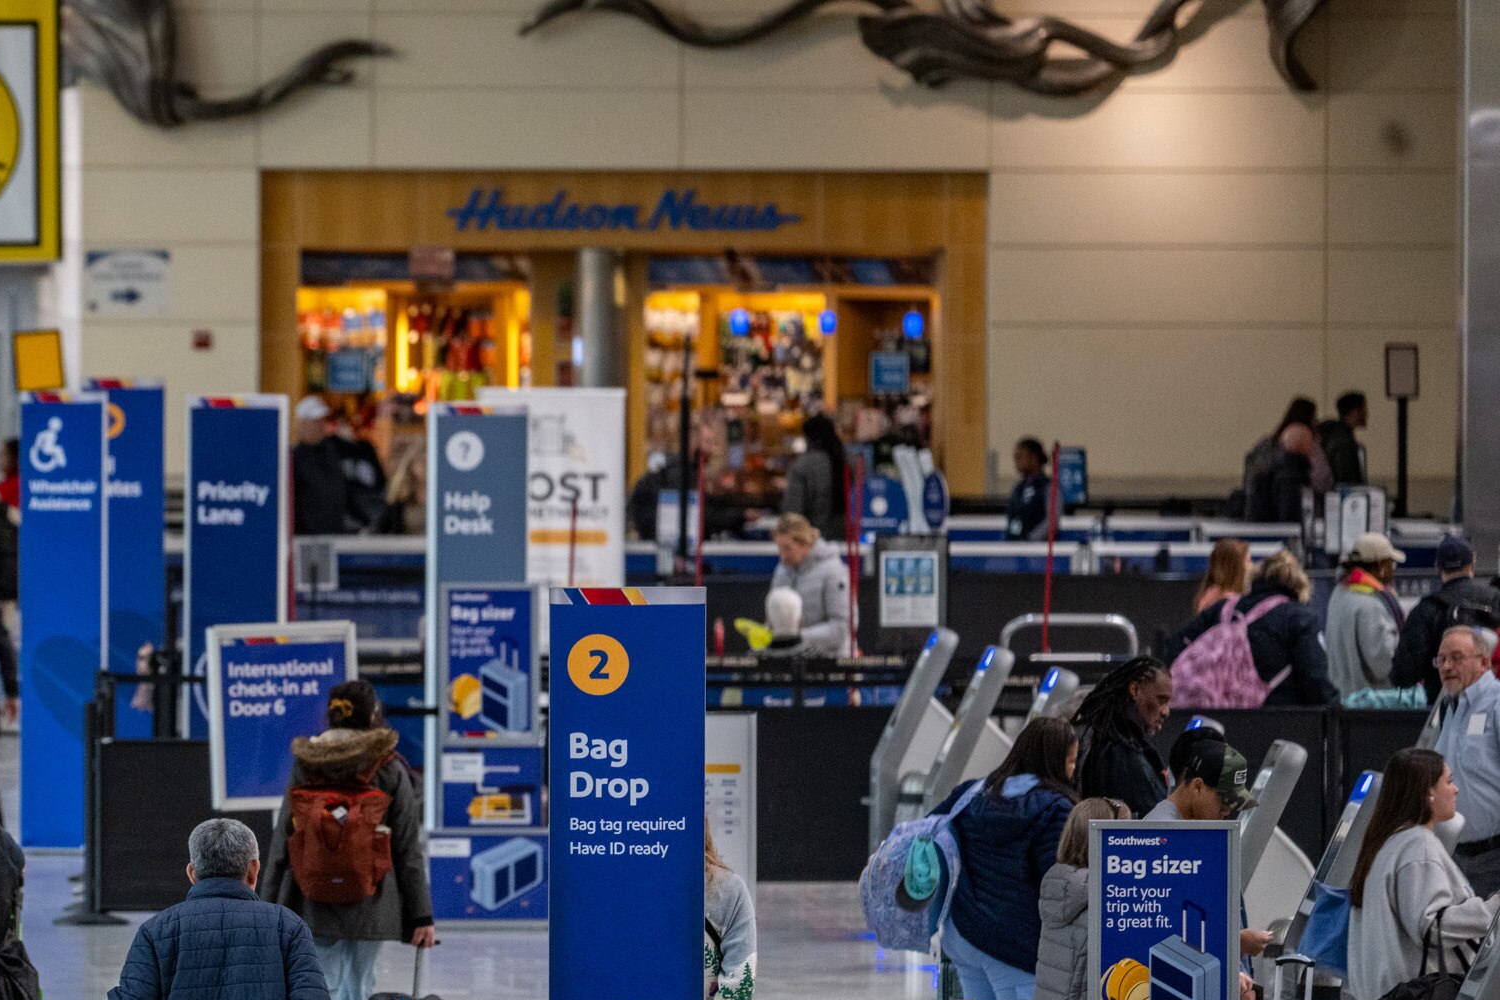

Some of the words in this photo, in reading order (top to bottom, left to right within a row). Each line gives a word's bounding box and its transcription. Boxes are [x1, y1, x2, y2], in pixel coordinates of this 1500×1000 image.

[446, 188, 641, 231] Hudson
[643, 188, 803, 231] News
[28, 479, 97, 495] Wheelchair
[197, 481, 270, 507] Priority
[528, 472, 607, 502] OST
[28, 497, 93, 511] Assistance
[444, 490, 492, 513] Help
[197, 505, 245, 526] Lane
[443, 514, 494, 536] Desk
[228, 658, 334, 679] International
[588, 649, 610, 680] 2
[228, 678, 299, 697] check-in
[301, 680, 320, 696] at
[229, 699, 271, 717] Door
[273, 698, 286, 716] 6
[569, 732, 629, 768] Bag
[569, 771, 650, 806] Drop
[569, 817, 597, 835] Bag
[600, 818, 623, 835] tag
[626, 816, 686, 835] required
[569, 841, 606, 855] Have
[609, 841, 626, 855] ID
[629, 841, 669, 859] ready
[1107, 836, 1161, 846] Southwest
[1106, 854, 1147, 879] Bag
[1152, 854, 1203, 875] sizer
[1106, 884, 1138, 898] Start
[1140, 887, 1172, 901] your
[1106, 900, 1130, 916] trip
[1132, 900, 1162, 913] with
[1106, 917, 1114, 928] a
[1117, 916, 1153, 931] great
[1155, 915, 1173, 928] fit.
